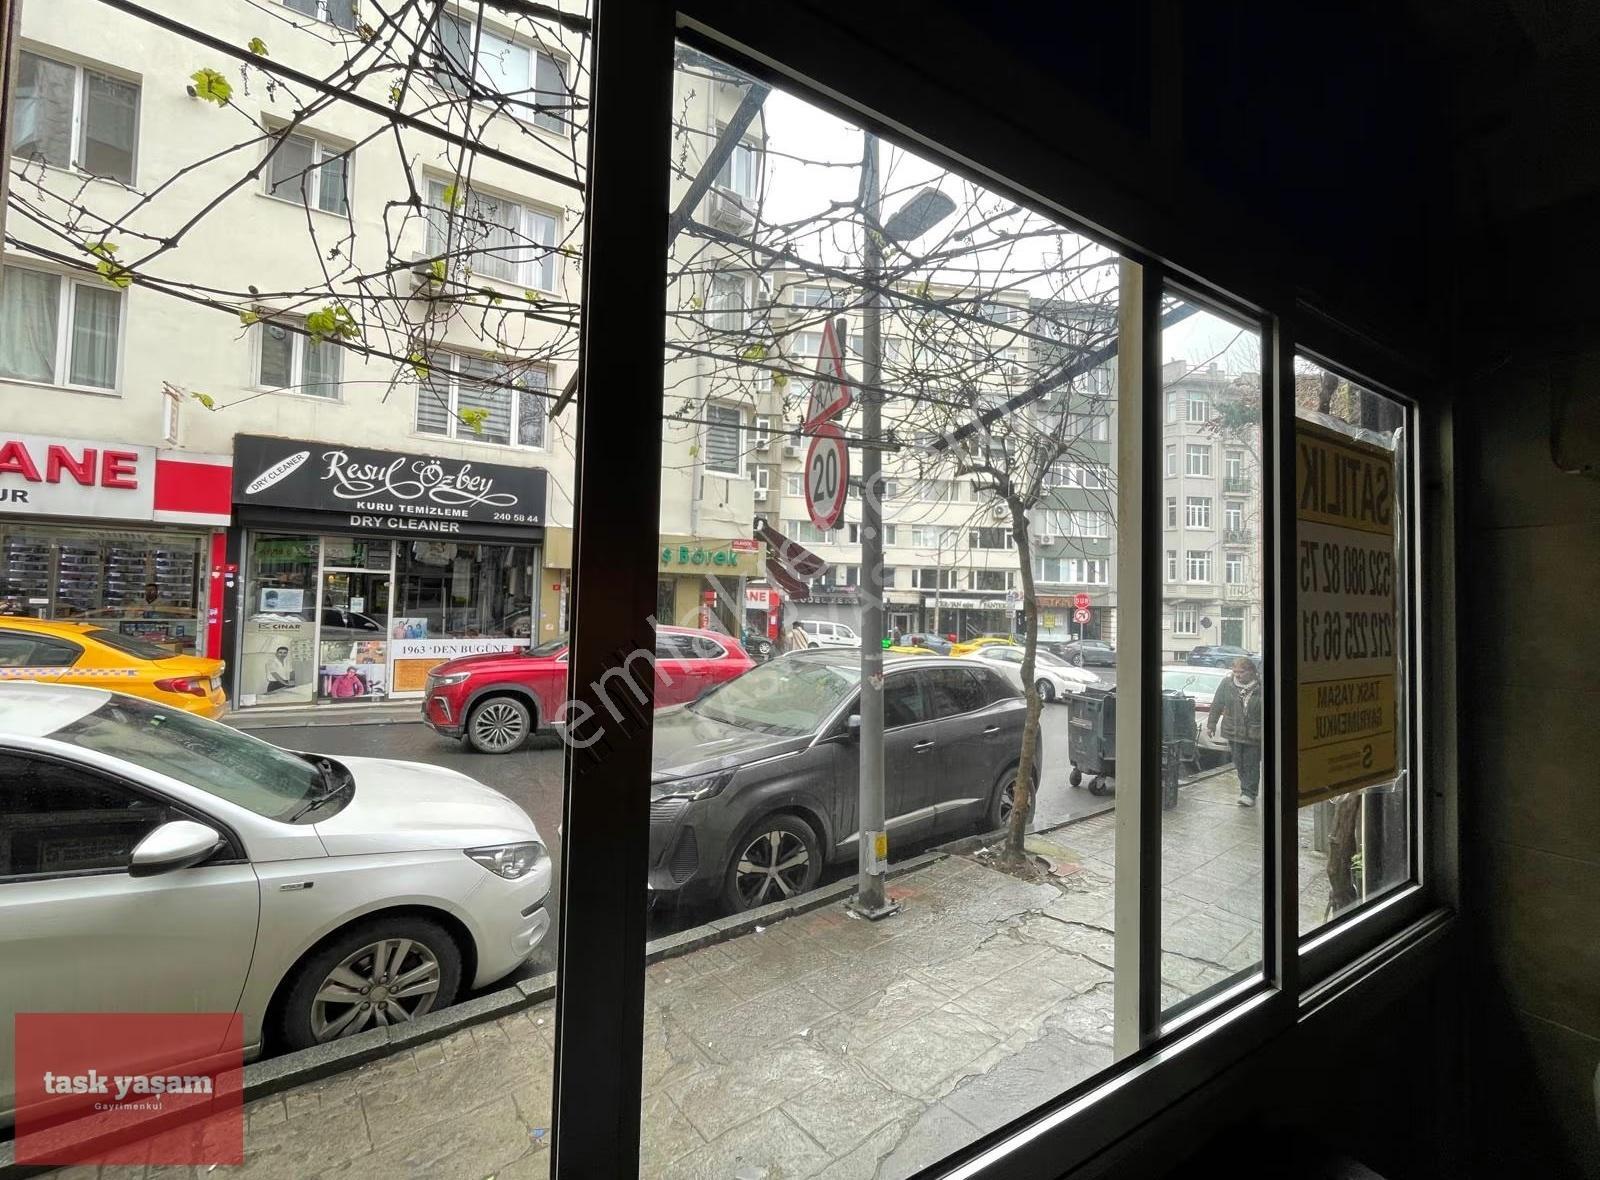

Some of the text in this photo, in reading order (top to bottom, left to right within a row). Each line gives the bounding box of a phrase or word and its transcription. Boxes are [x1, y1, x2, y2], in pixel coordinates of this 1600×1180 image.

[0, 441, 138, 489] ANE
[251, 454, 304, 491] DRY CLEANER
[813, 447, 837, 502] 20
[320, 450, 518, 507] Resul Özbey
[356, 501, 469, 518] KURU TEMİZLEME
[494, 512, 511, 522] 240
[527, 514, 539, 523] 44
[350, 515, 460, 533] DRY CLEANER
[678, 545, 738, 567] Börek
[402, 645, 426, 654] 1963
